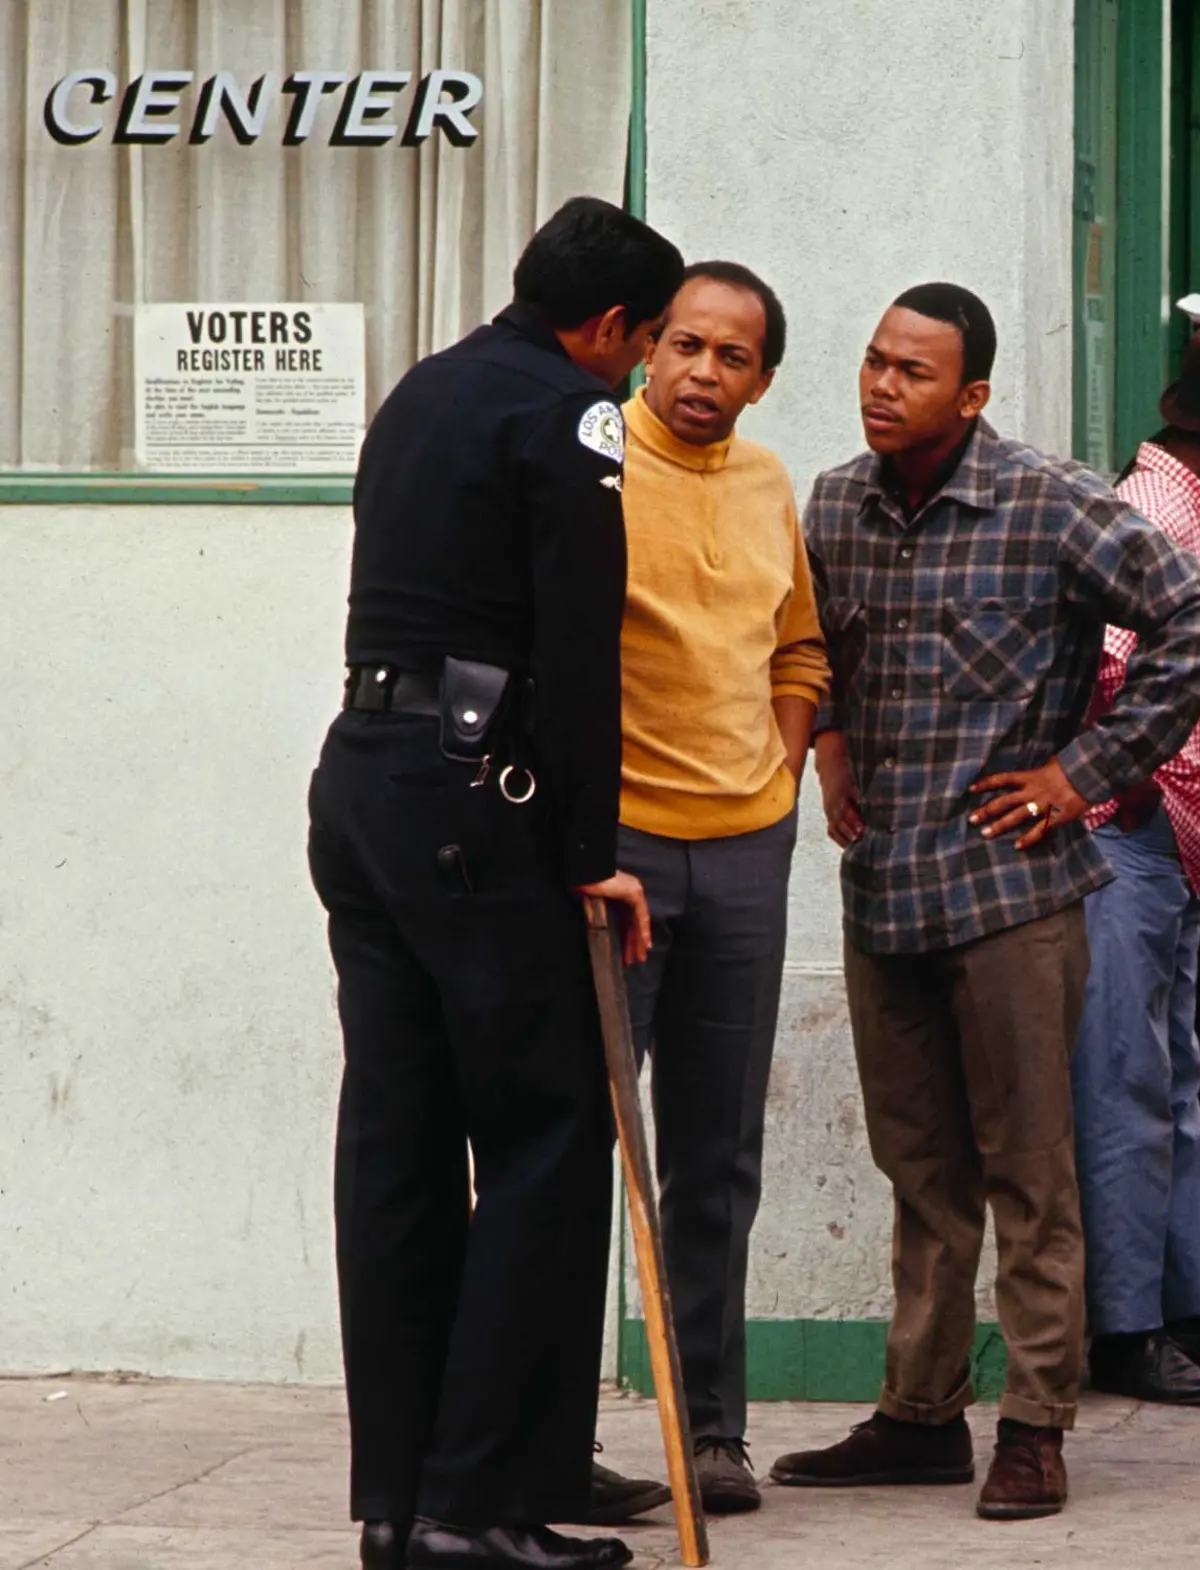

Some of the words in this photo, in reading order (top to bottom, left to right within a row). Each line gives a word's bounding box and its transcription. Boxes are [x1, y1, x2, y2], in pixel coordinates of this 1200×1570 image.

[44, 69, 484, 147] CENTER
[186, 311, 313, 344] VOTERS
[177, 349, 265, 371] REGISTER
[275, 349, 323, 371] HERE
